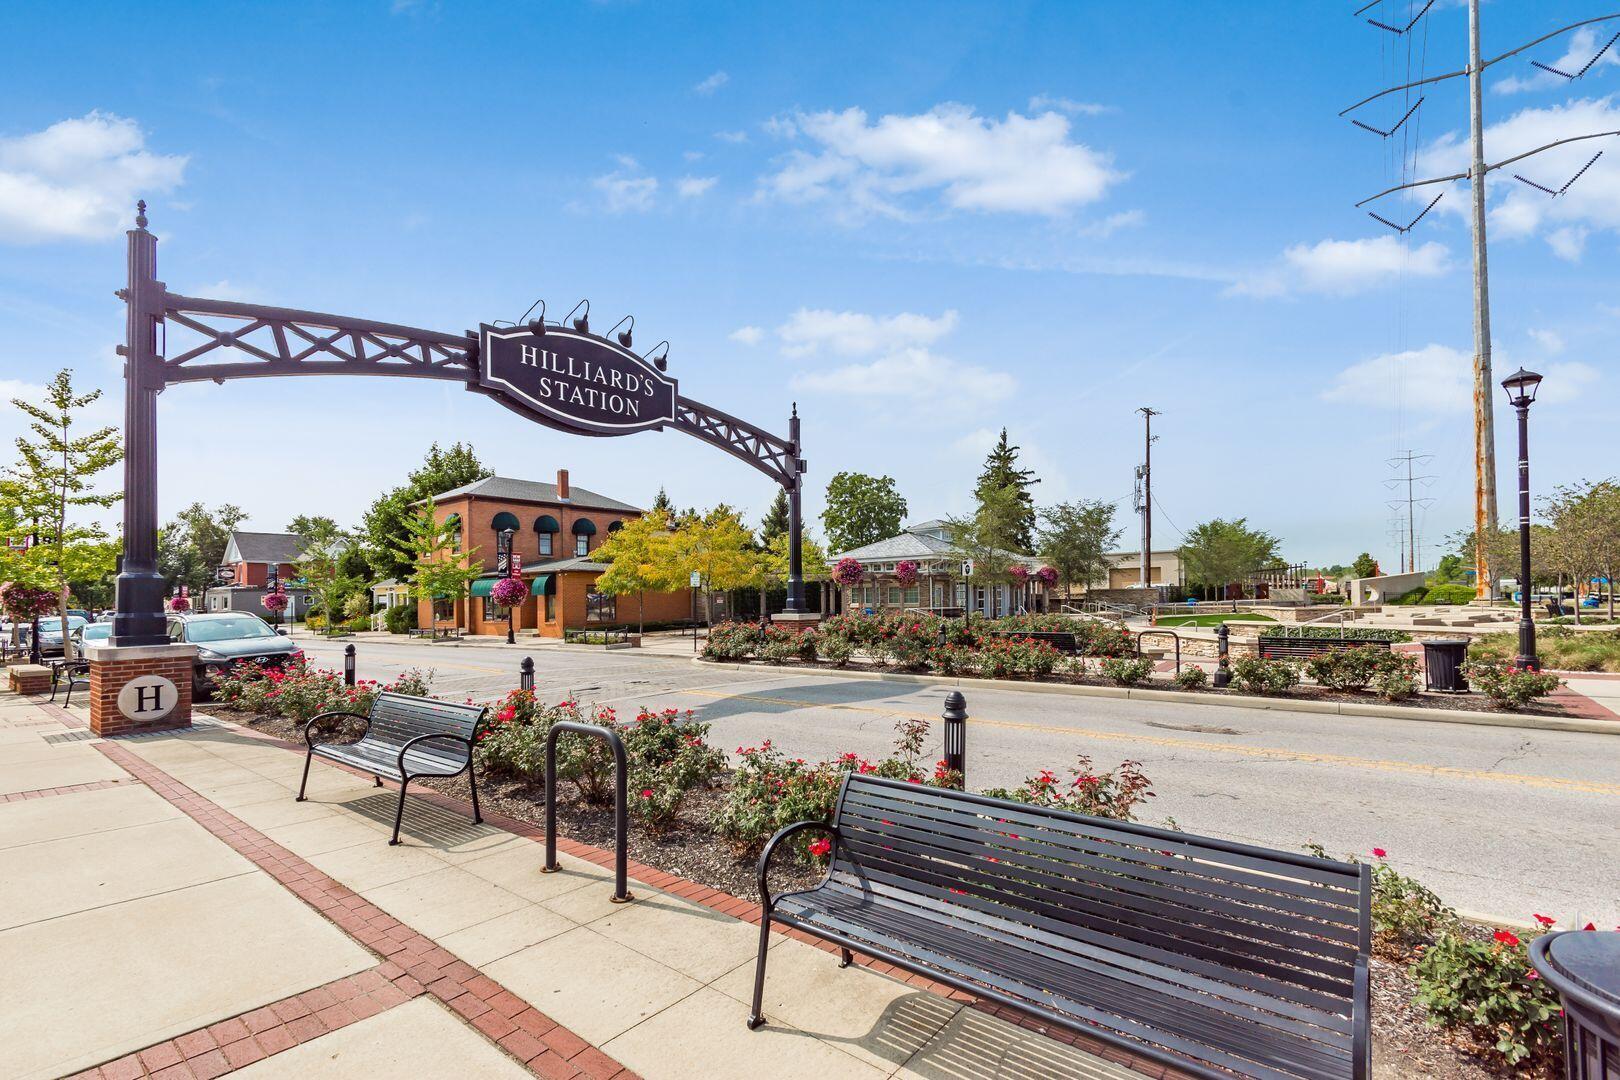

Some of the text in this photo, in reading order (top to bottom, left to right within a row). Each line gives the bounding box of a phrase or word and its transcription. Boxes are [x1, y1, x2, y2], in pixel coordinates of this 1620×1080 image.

[520, 344, 654, 397] HILLIARD'S
[539, 377, 640, 417] STATION
[134, 684, 164, 713] H
